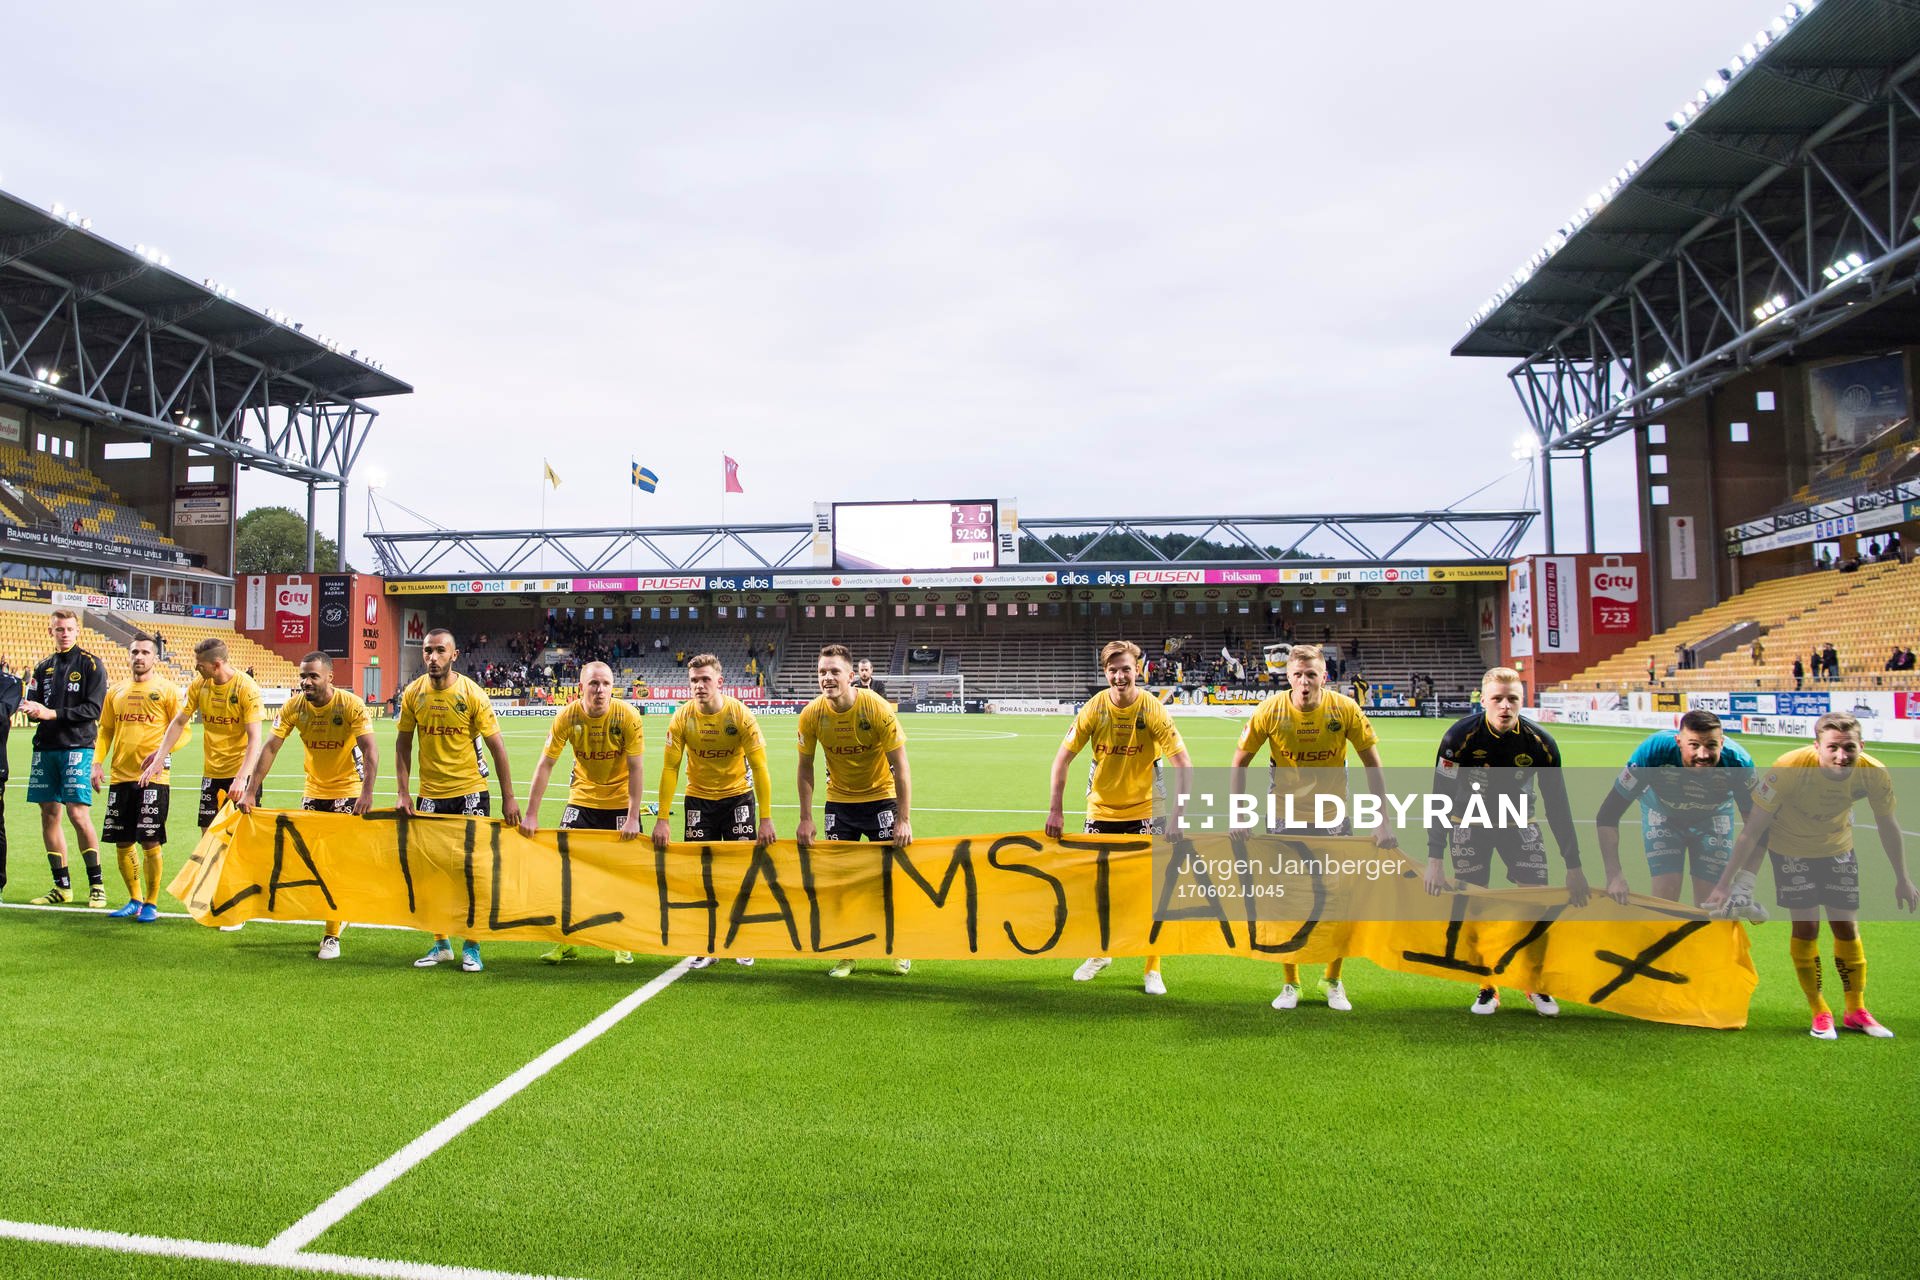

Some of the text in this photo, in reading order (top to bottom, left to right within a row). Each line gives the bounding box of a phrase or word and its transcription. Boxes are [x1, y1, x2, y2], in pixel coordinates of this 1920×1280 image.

[958, 513, 964, 523] 2
[978, 512, 986, 523] 0
[956, 528, 988, 540] 92:06
[95, 542, 102, 550] TO
[104, 544, 122, 554] CLUBS
[123, 547, 132, 555] ON
[133, 548, 142, 556] ALL
[974, 550, 990, 560] put
[1061, 572, 1089, 584] ellos
[1098, 571, 1125, 584] ellos
[1134, 571, 1200, 582] PULSEN
[1222, 570, 1261, 580] Folksam
[1300, 570, 1312, 581] put
[1338, 570, 1350, 581] put
[1456, 570, 1504, 578] TILLSAMMANS
[524, 582, 536, 592] put
[556, 581, 568, 592] put
[588, 580, 622, 590] Folksam
[642, 578, 701, 590] PULSEN
[710, 576, 735, 590] ellos
[743, 576, 769, 589] ellos
[1595, 573, 1632, 591] City
[87, 596, 108, 604] SPEED
[279, 590, 308, 606] City
[116, 598, 149, 612] SERNEKE
[1600, 612, 1630, 623] 7-23
[282, 624, 304, 634] 7-23
[67, 682, 80, 692] 30
[654, 688, 670, 698] Ger
[738, 687, 760, 698] kort!
[575, 750, 626, 760] PULSEN
[1095, 744, 1144, 756] PULSEN
[1281, 748, 1338, 762] PULSEN
[140, 804, 158, 815] ellos
[732, 824, 754, 834] ellos
[361, 809, 625, 936] TILL
[654, 835, 1327, 956] HALMSTAD
